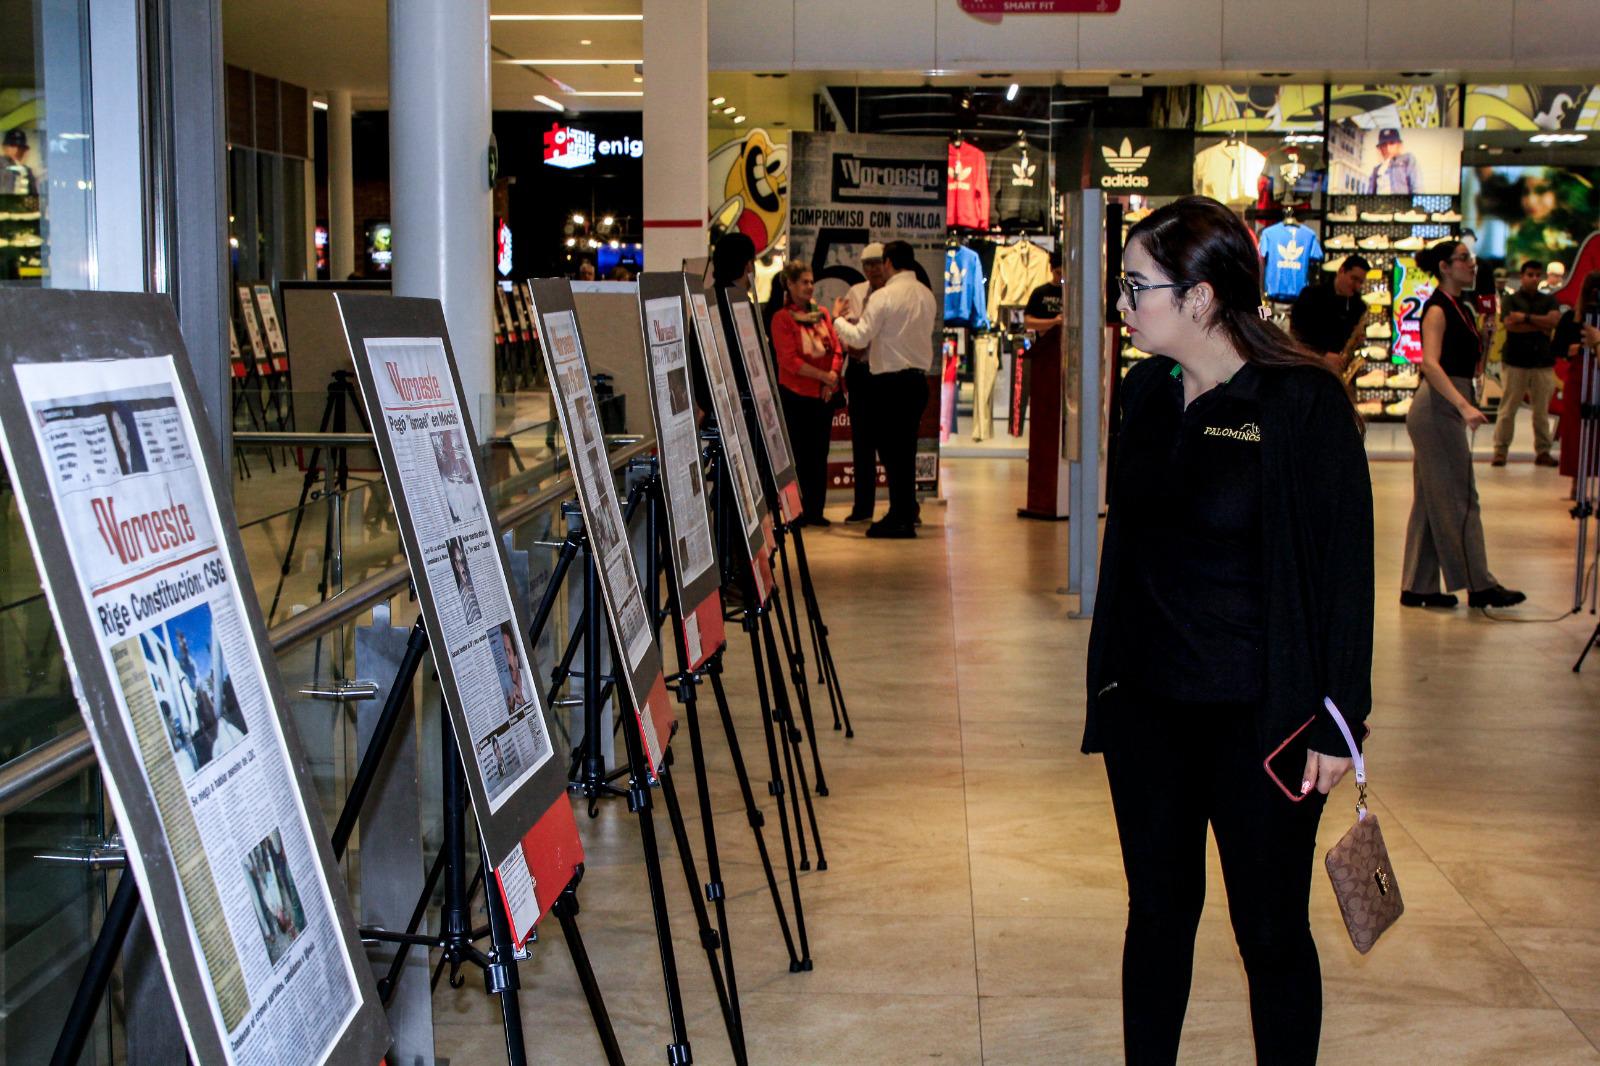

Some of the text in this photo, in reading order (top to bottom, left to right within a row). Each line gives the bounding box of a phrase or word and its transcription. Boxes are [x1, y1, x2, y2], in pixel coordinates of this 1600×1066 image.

[1003, 1, 1036, 10] SMART
[1039, 1, 1055, 10] FIT
[840, 158, 939, 187] Noroeste
[1101, 174, 1149, 187] adidas
[790, 208, 941, 229] COMPROMISO CON SINALOA
[385, 361, 442, 401] Noroeste
[388, 414, 406, 435] Pegó
[431, 415, 440, 427] en
[1203, 426, 1261, 442] PALOMINOS
[91, 483, 196, 565] Noroeste
[98, 558, 227, 636] Rige Constitución: CSG
